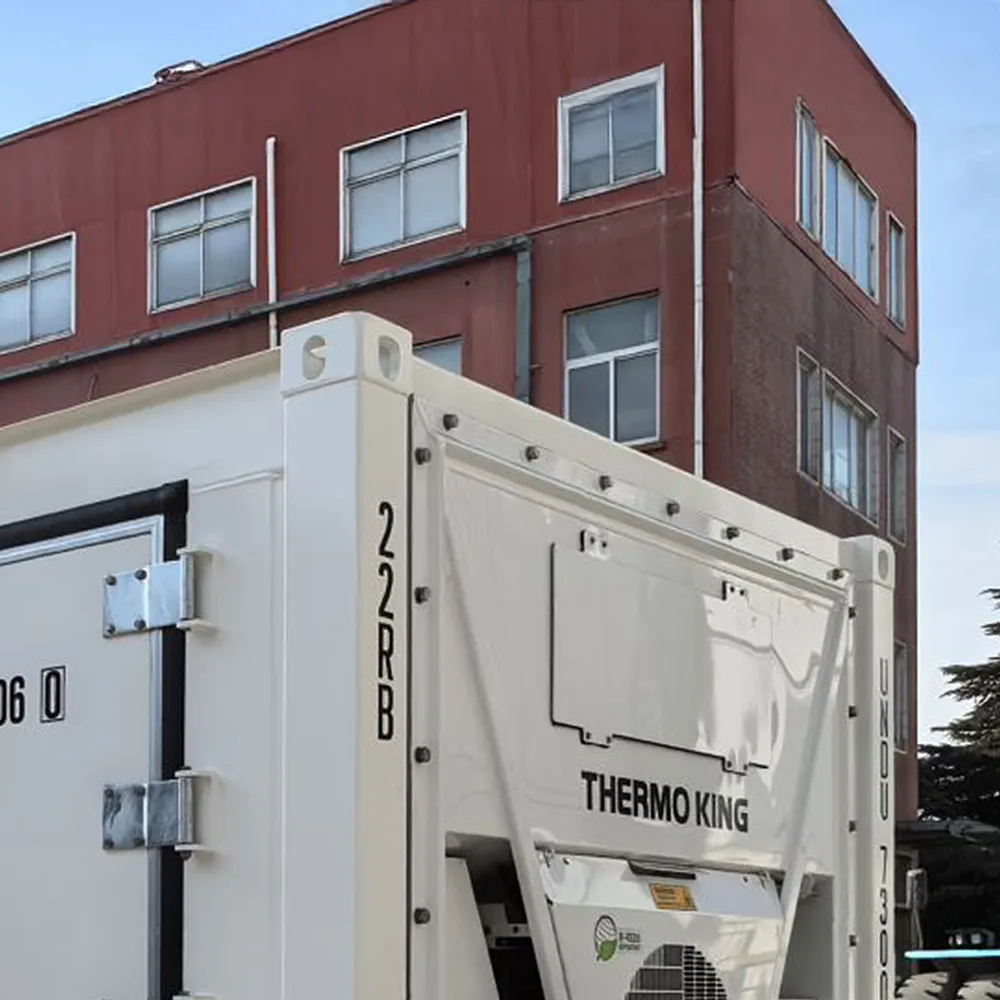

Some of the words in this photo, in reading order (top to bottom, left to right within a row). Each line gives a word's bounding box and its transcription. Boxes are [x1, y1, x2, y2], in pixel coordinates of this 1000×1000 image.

[378, 501, 395, 741] 22RB
[45, 670, 62, 719] 0
[581, 770, 690, 825] THERMO
[695, 791, 749, 833] KING
